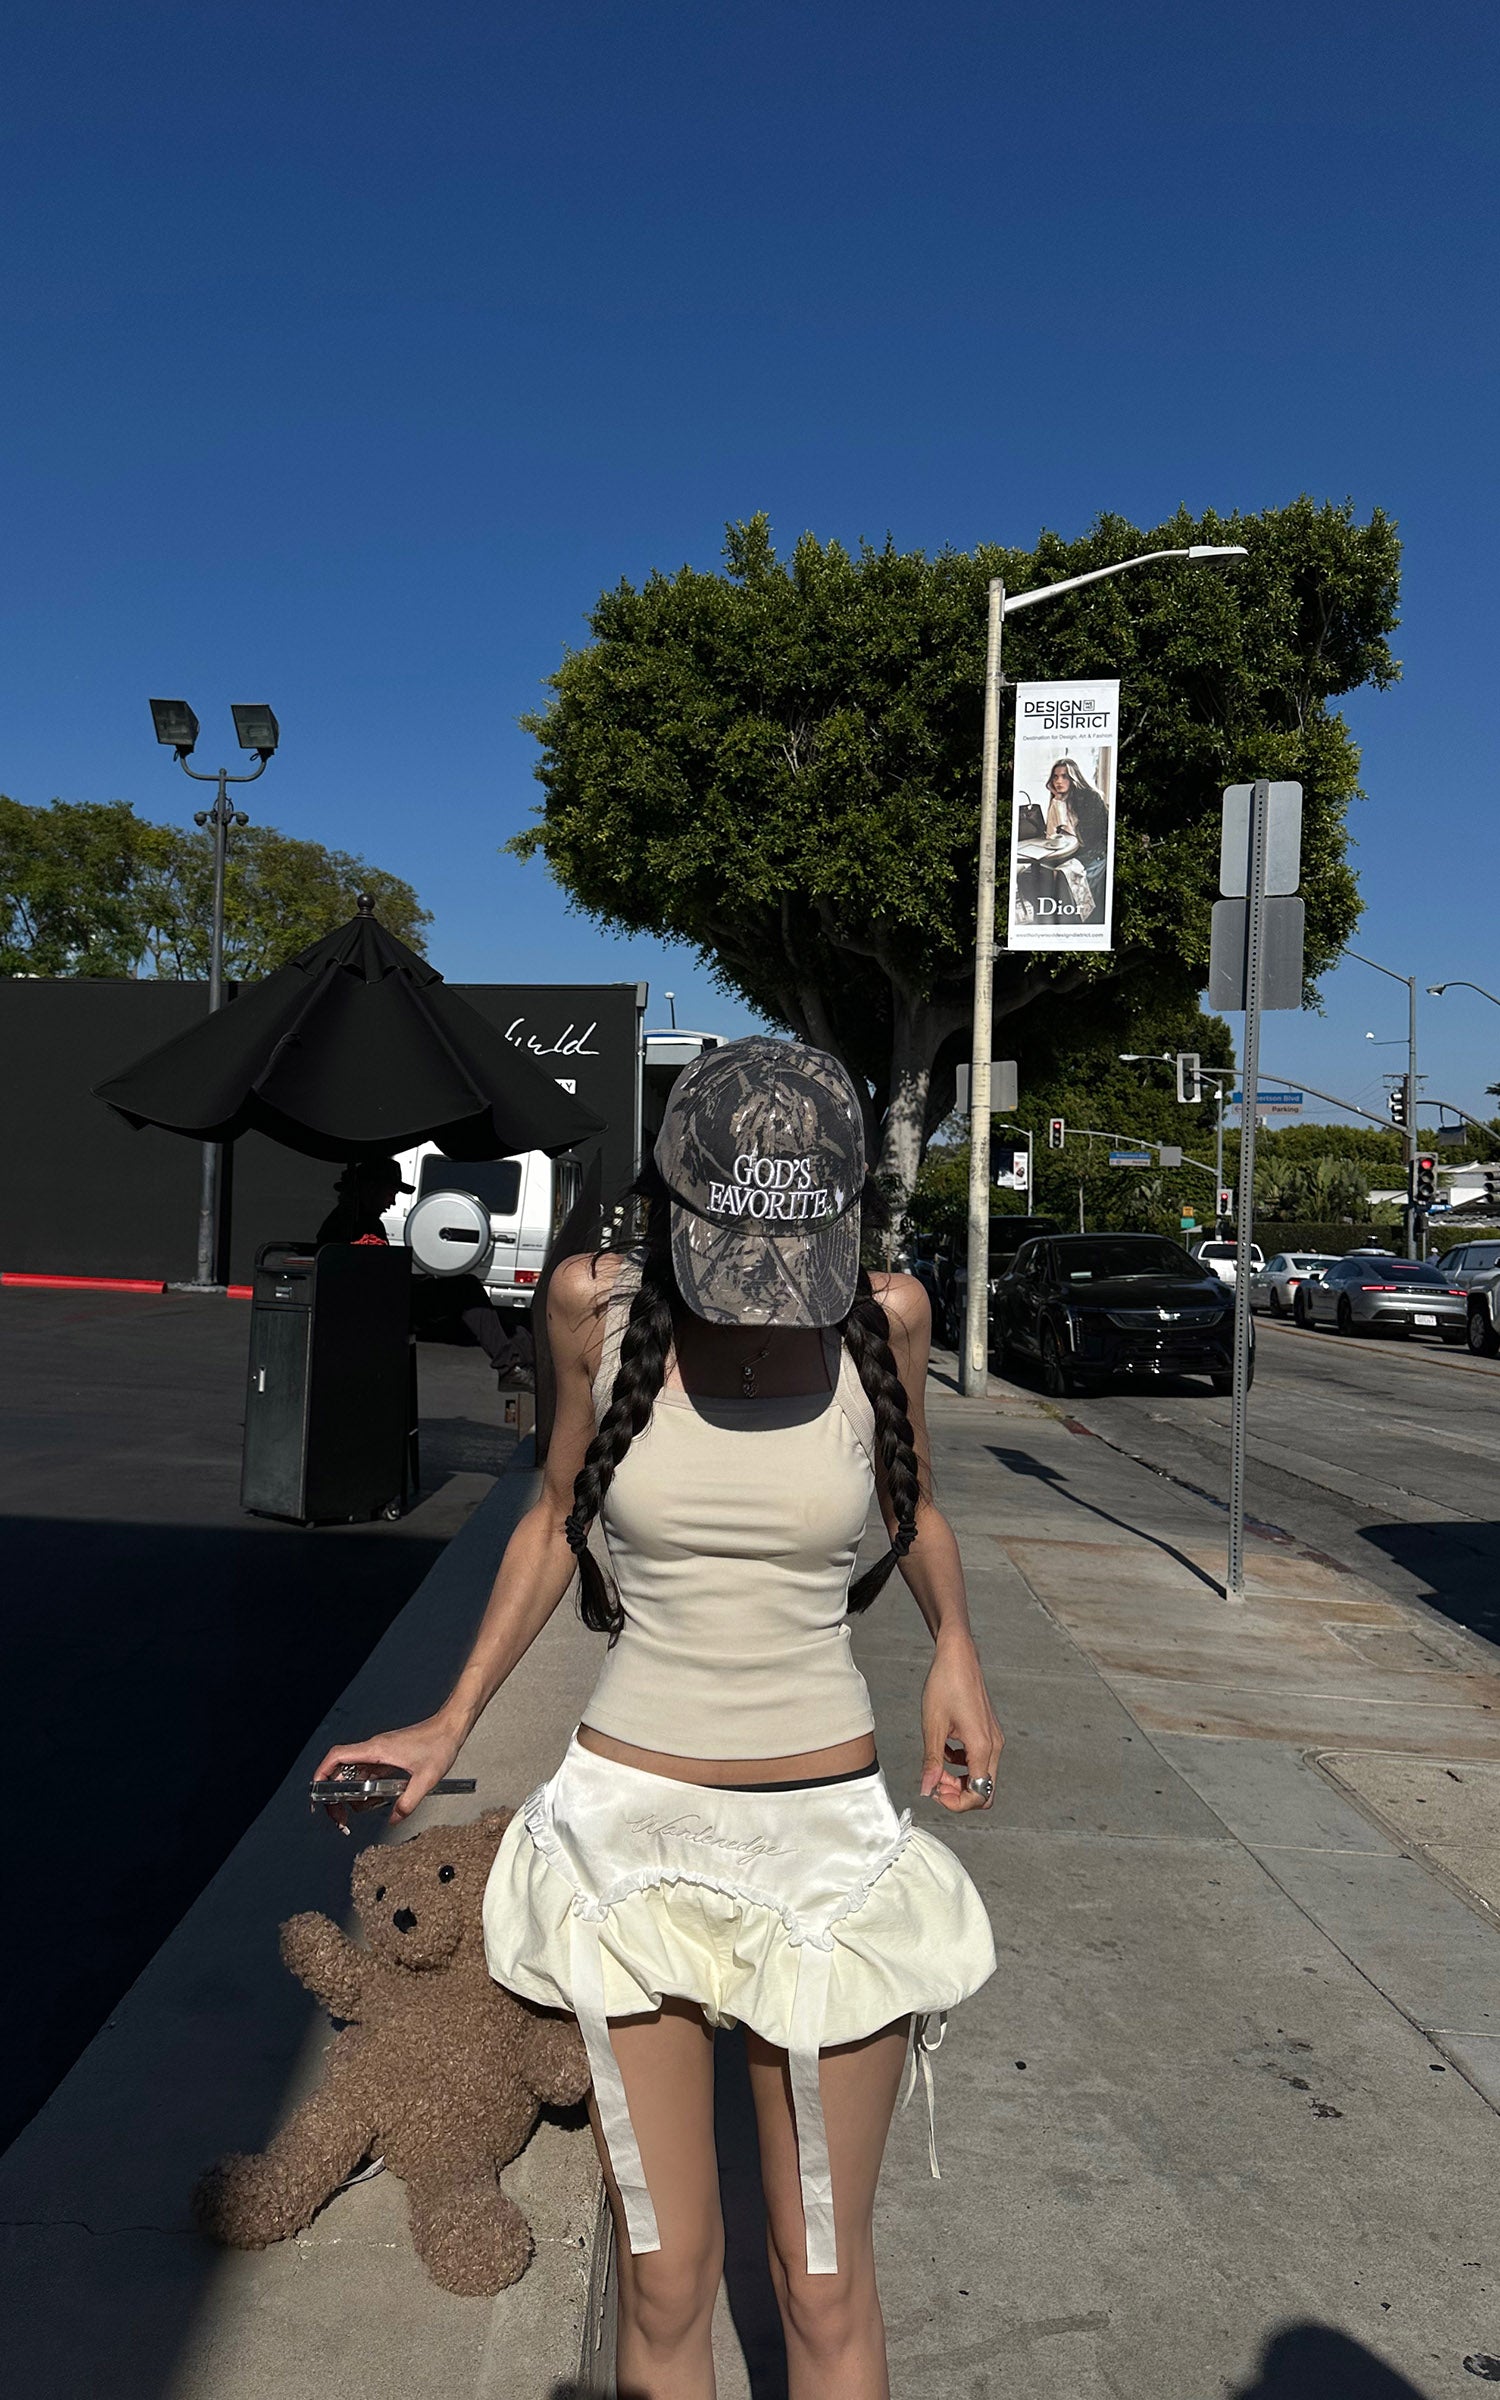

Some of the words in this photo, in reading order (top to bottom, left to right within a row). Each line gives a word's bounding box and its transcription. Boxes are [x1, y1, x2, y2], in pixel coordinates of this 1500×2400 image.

[1024, 700, 1082, 714] DESIGN
[1043, 713, 1110, 729] DISTRICT
[1036, 897, 1084, 915] Dior
[1283, 1094, 1300, 1102] Blvd
[1272, 1105, 1300, 1113] Parking
[733, 1154, 812, 1190] GOD'S
